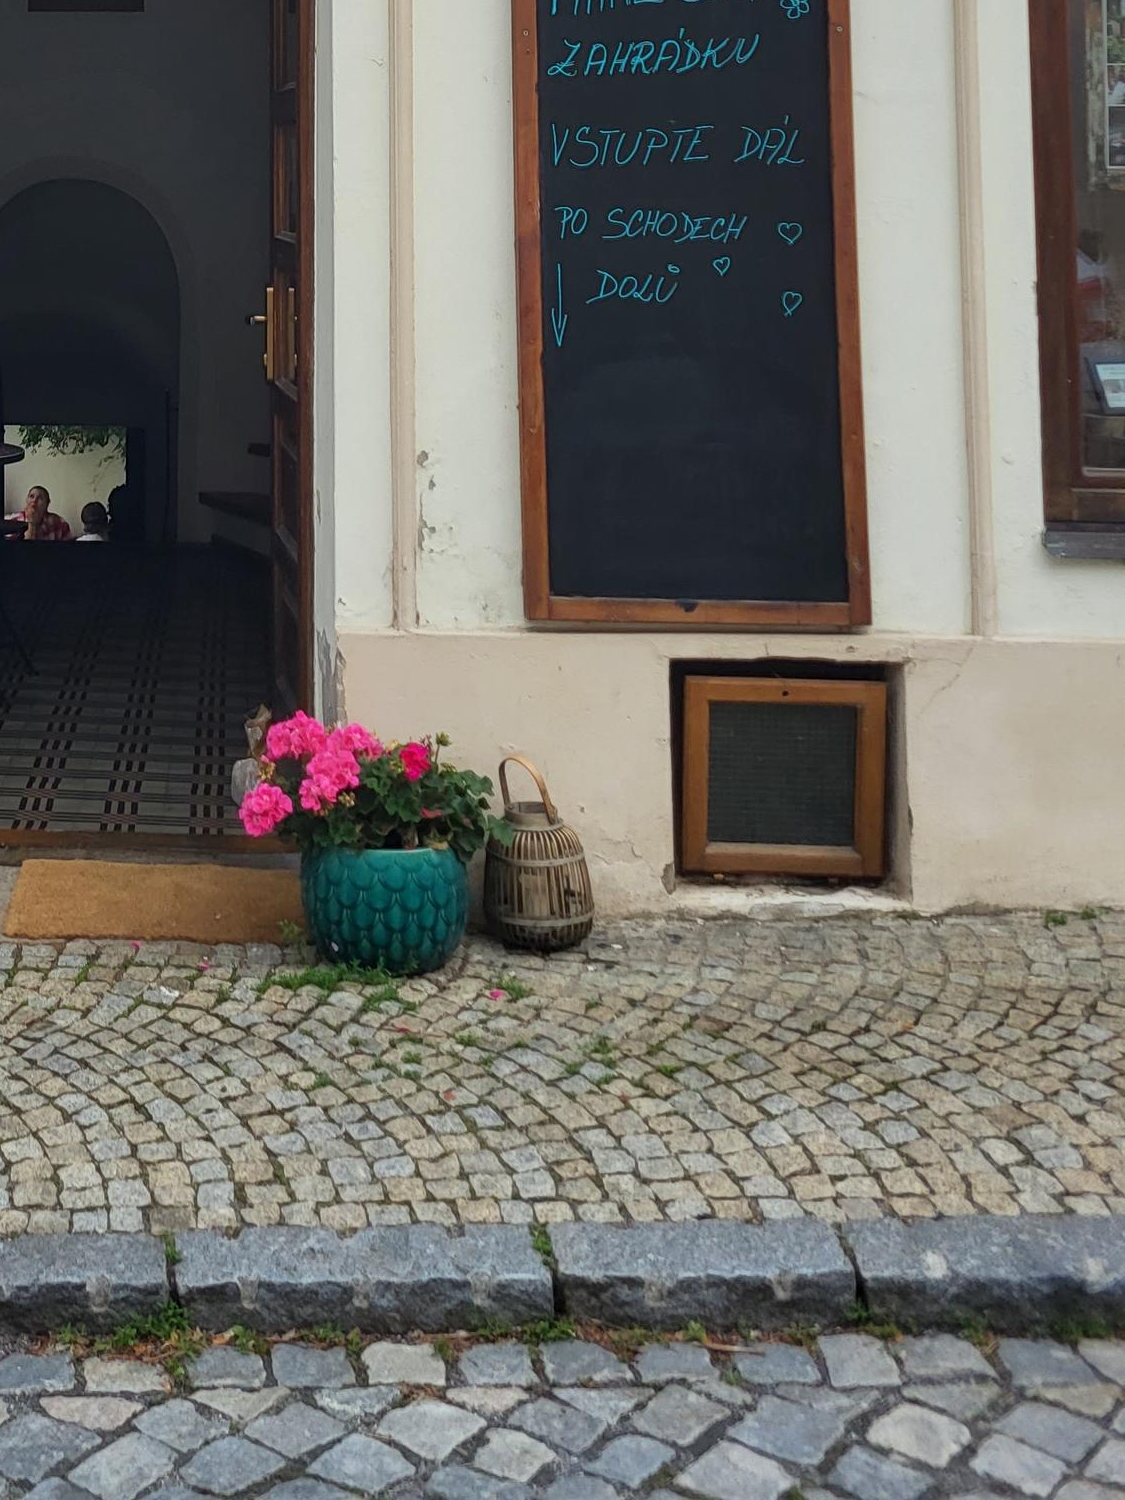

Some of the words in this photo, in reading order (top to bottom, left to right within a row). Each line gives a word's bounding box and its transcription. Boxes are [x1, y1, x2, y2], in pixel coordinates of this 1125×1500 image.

[547, 28, 759, 77] ZAHRÁDKU
[551, 123, 714, 167] VSTUPTE
[734, 116, 805, 164] DÁL
[555, 206, 589, 240] PO
[602, 207, 748, 244] SCHODECH
[586, 263, 681, 305] DOLŮ
